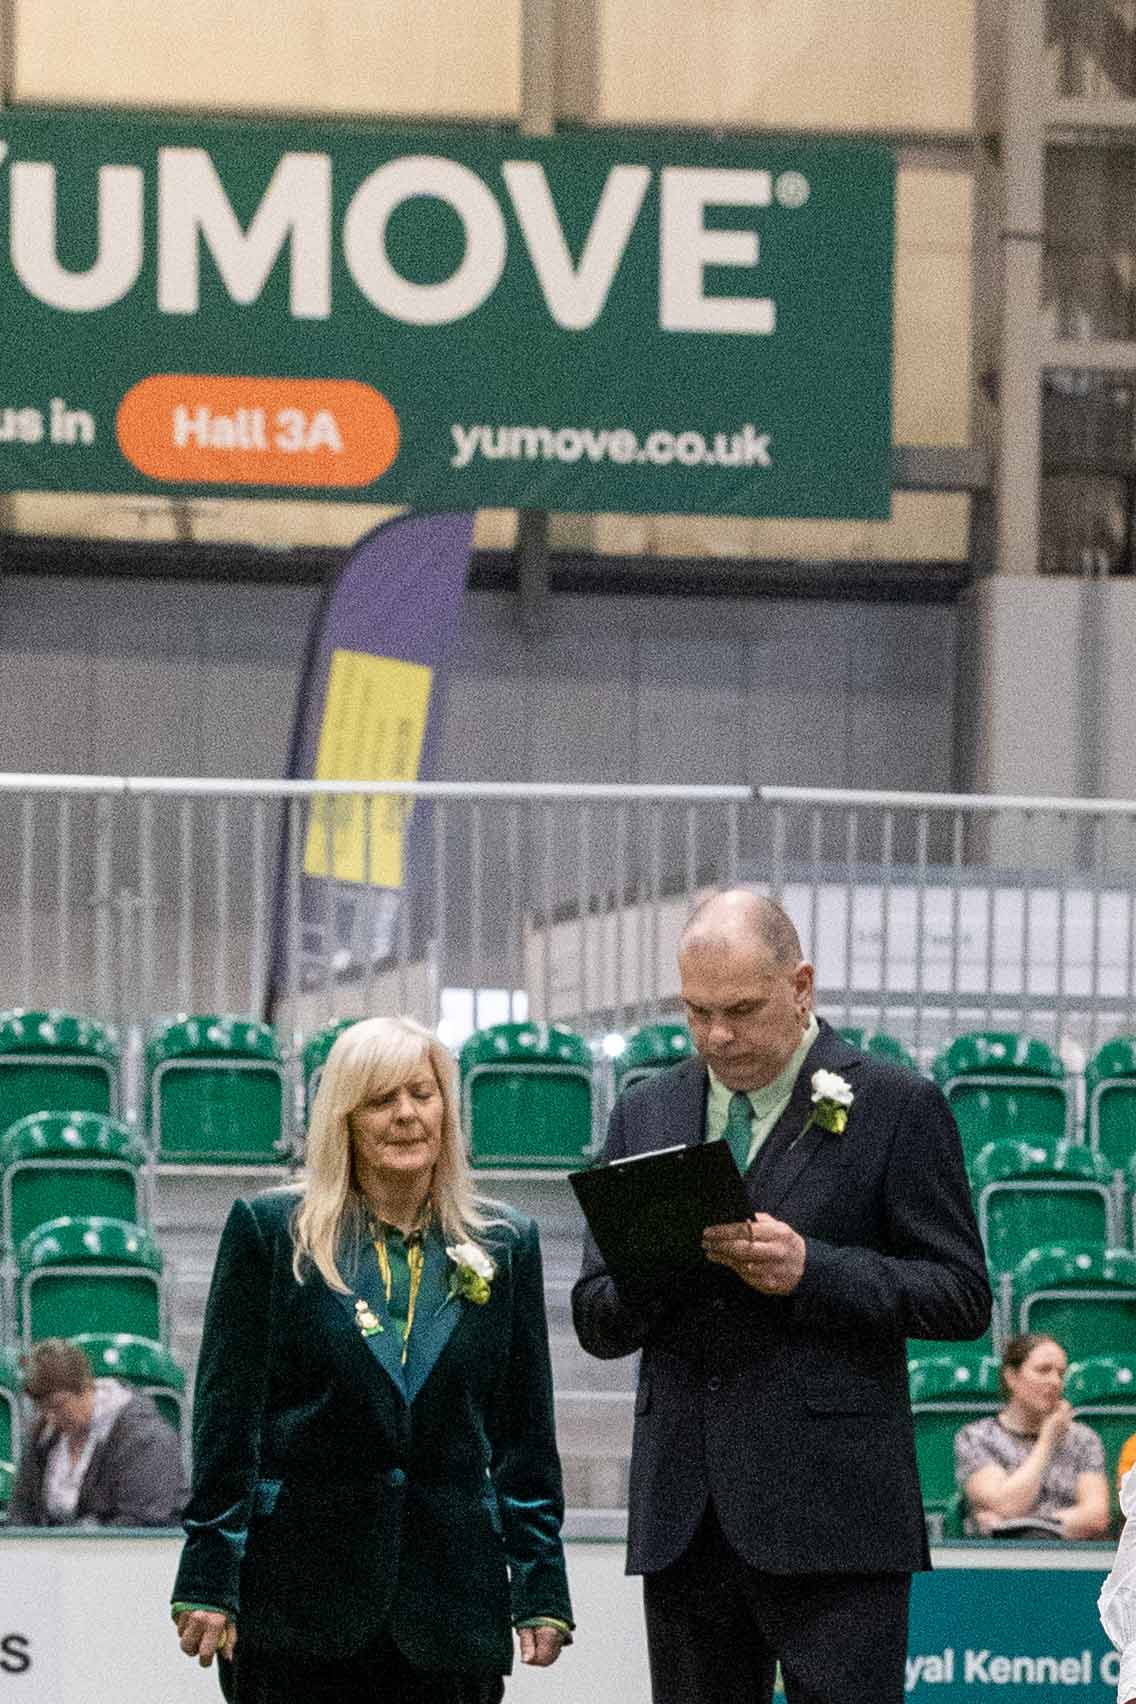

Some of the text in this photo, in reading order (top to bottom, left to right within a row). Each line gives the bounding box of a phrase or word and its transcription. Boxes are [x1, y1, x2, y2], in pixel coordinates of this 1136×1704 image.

[0, 139, 776, 335] UMOVE
[50, 398, 95, 445] in
[173, 405, 268, 450] Hall
[275, 408, 343, 453] 3A
[451, 423, 771, 468] yumove.co.uk
[904, 1648, 954, 1692] yal
[964, 1649, 1092, 1685] Kennel
